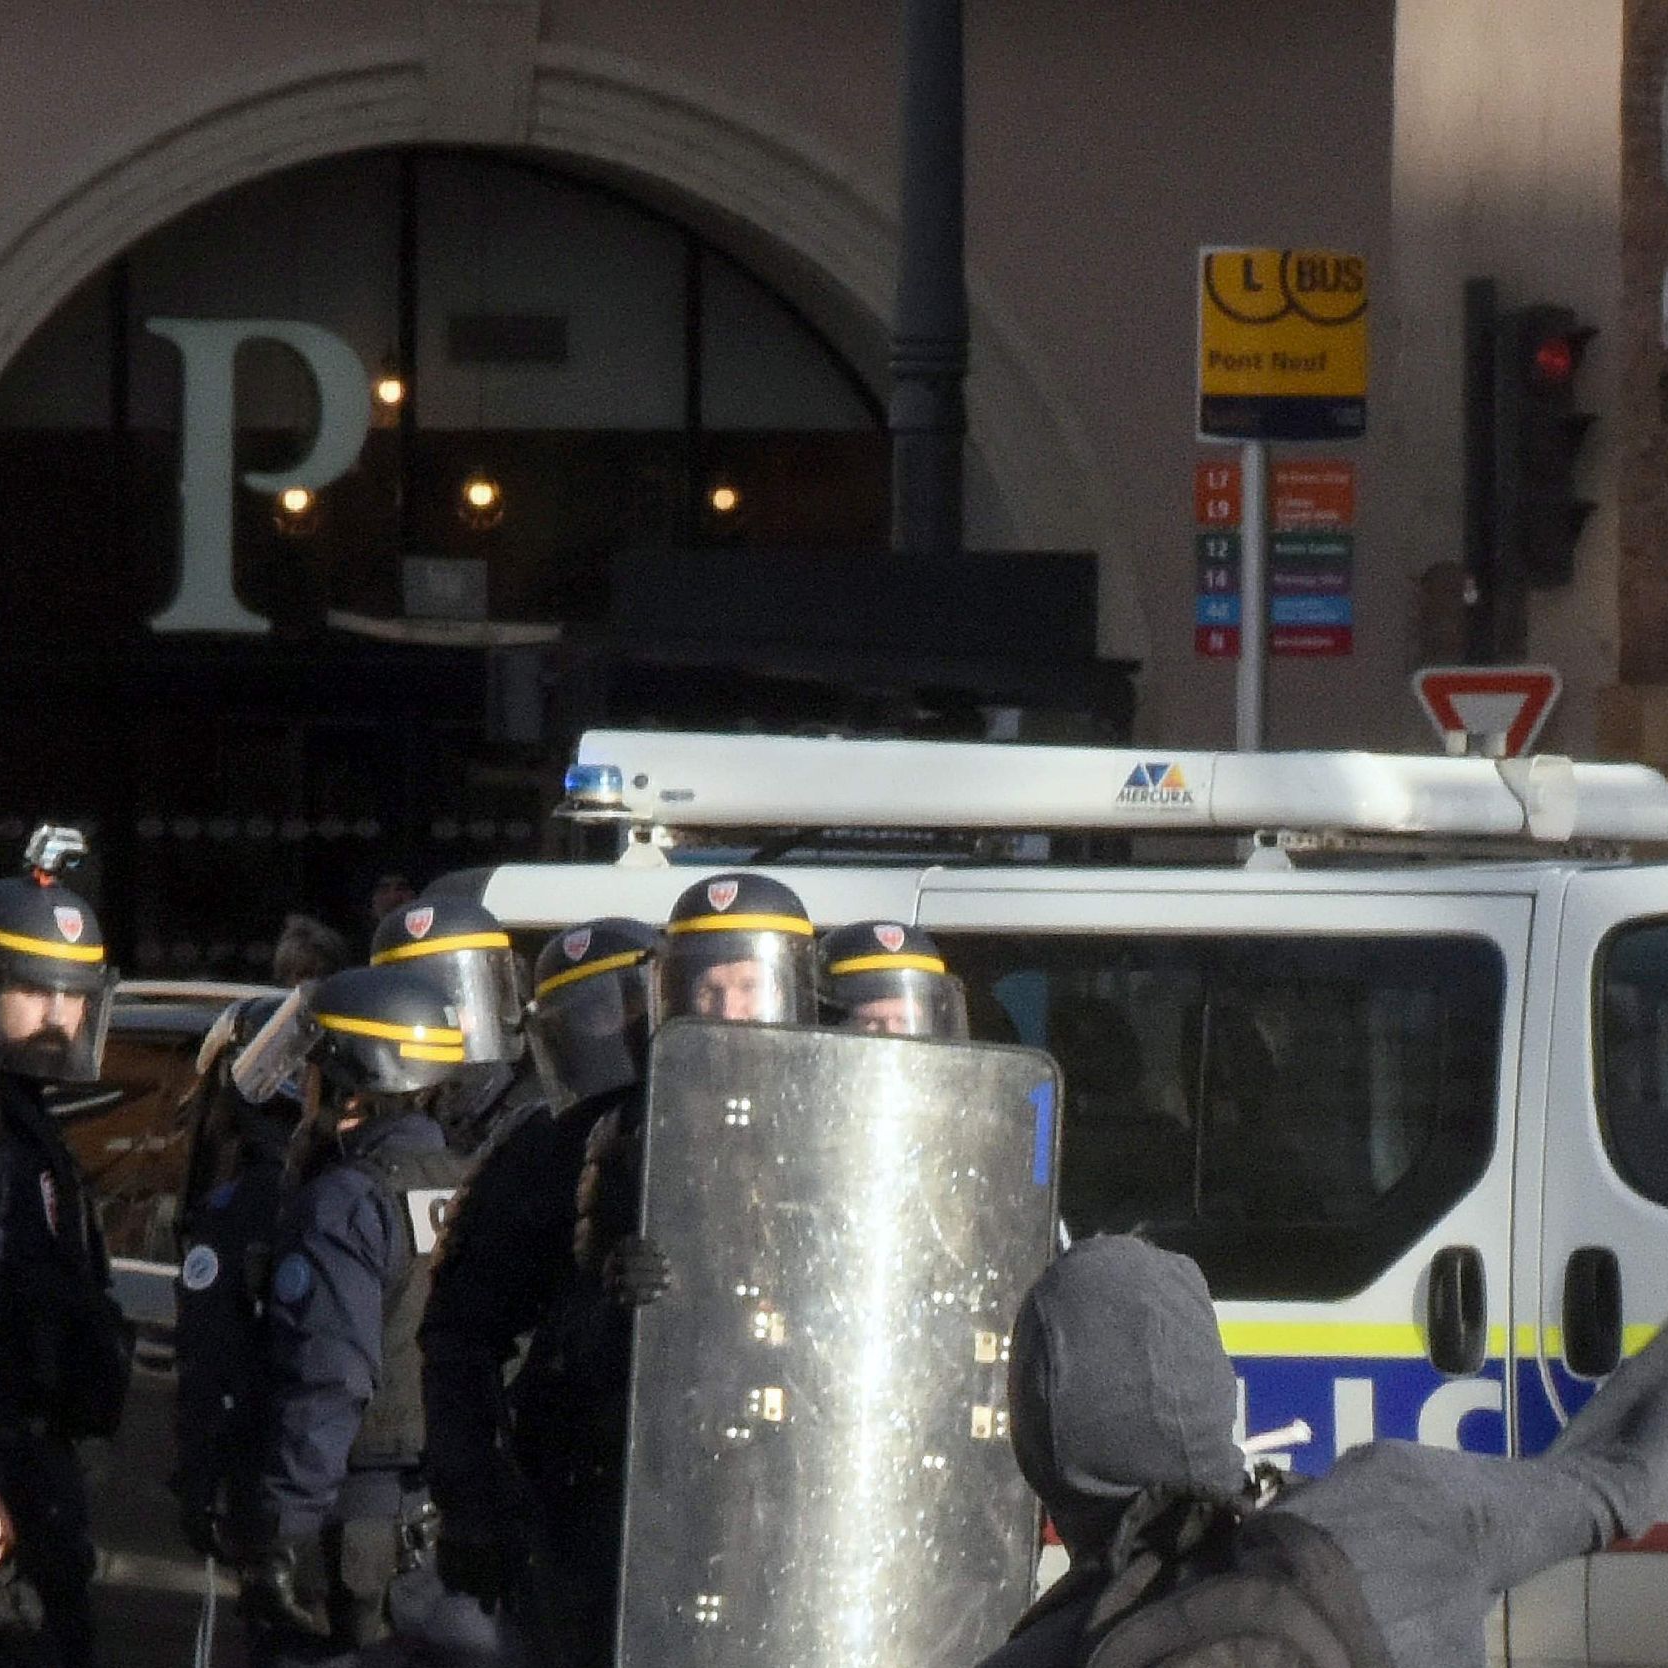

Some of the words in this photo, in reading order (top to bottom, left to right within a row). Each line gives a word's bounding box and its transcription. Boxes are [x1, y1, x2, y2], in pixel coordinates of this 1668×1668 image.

[1297, 257, 1363, 293] BUS
[1209, 349, 1262, 372] Pont
[1272, 350, 1328, 372] Neuf
[144, 316, 371, 633] P
[1028, 1081, 1052, 1186] 1
